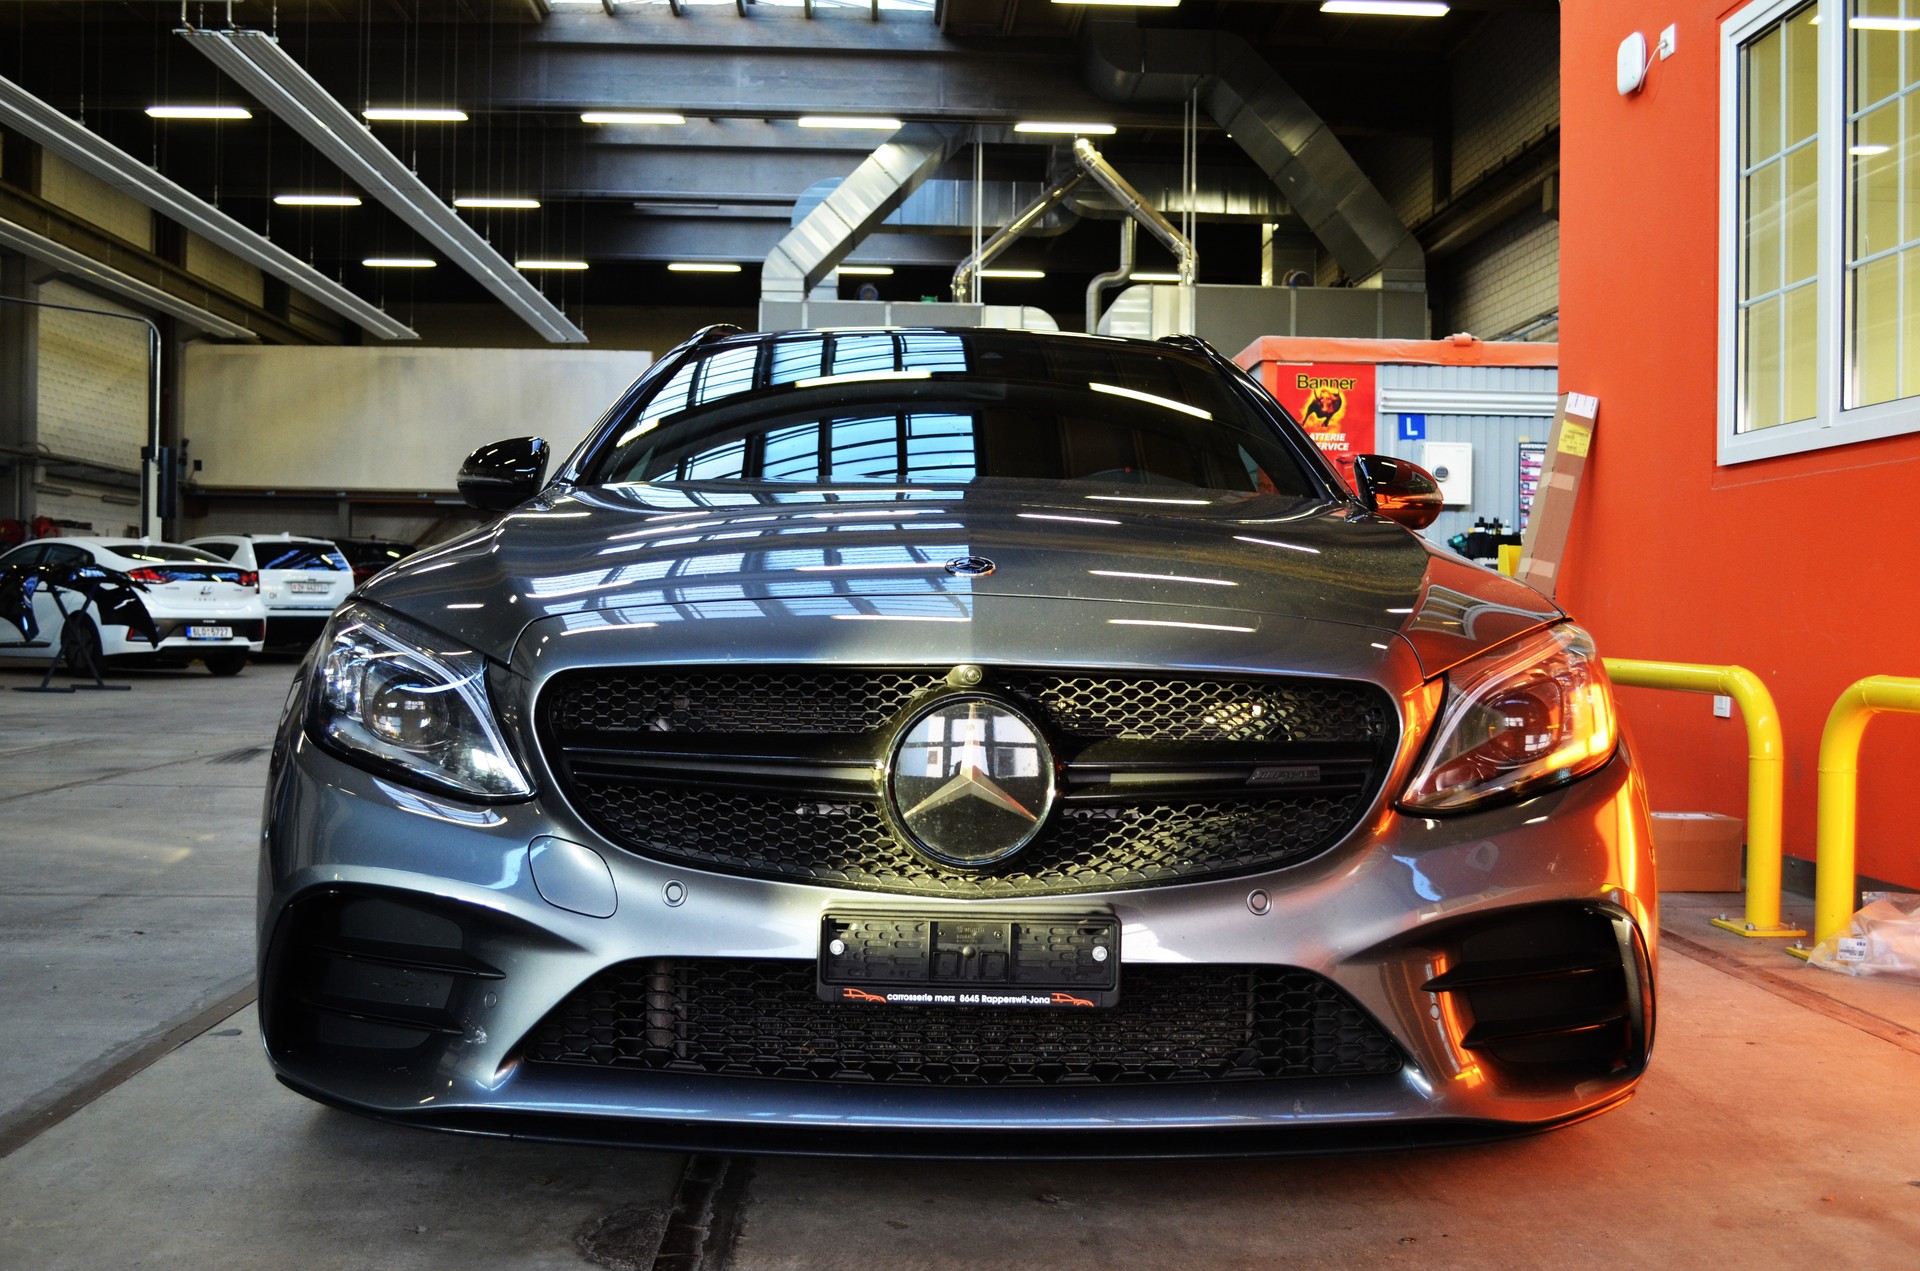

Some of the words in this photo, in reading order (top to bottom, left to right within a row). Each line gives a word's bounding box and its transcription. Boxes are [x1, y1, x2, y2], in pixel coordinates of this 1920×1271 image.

[1297, 374, 1356, 390] Banner
[1406, 417, 1418, 436] L
[1310, 432, 1346, 442] ATTERIE
[1316, 442, 1350, 451] ERVICE
[887, 993, 933, 1002] carrosserie
[934, 995, 956, 1003] merz
[960, 994, 980, 1003] 8645
[981, 994, 1051, 1005] Rapperswil-Jona
